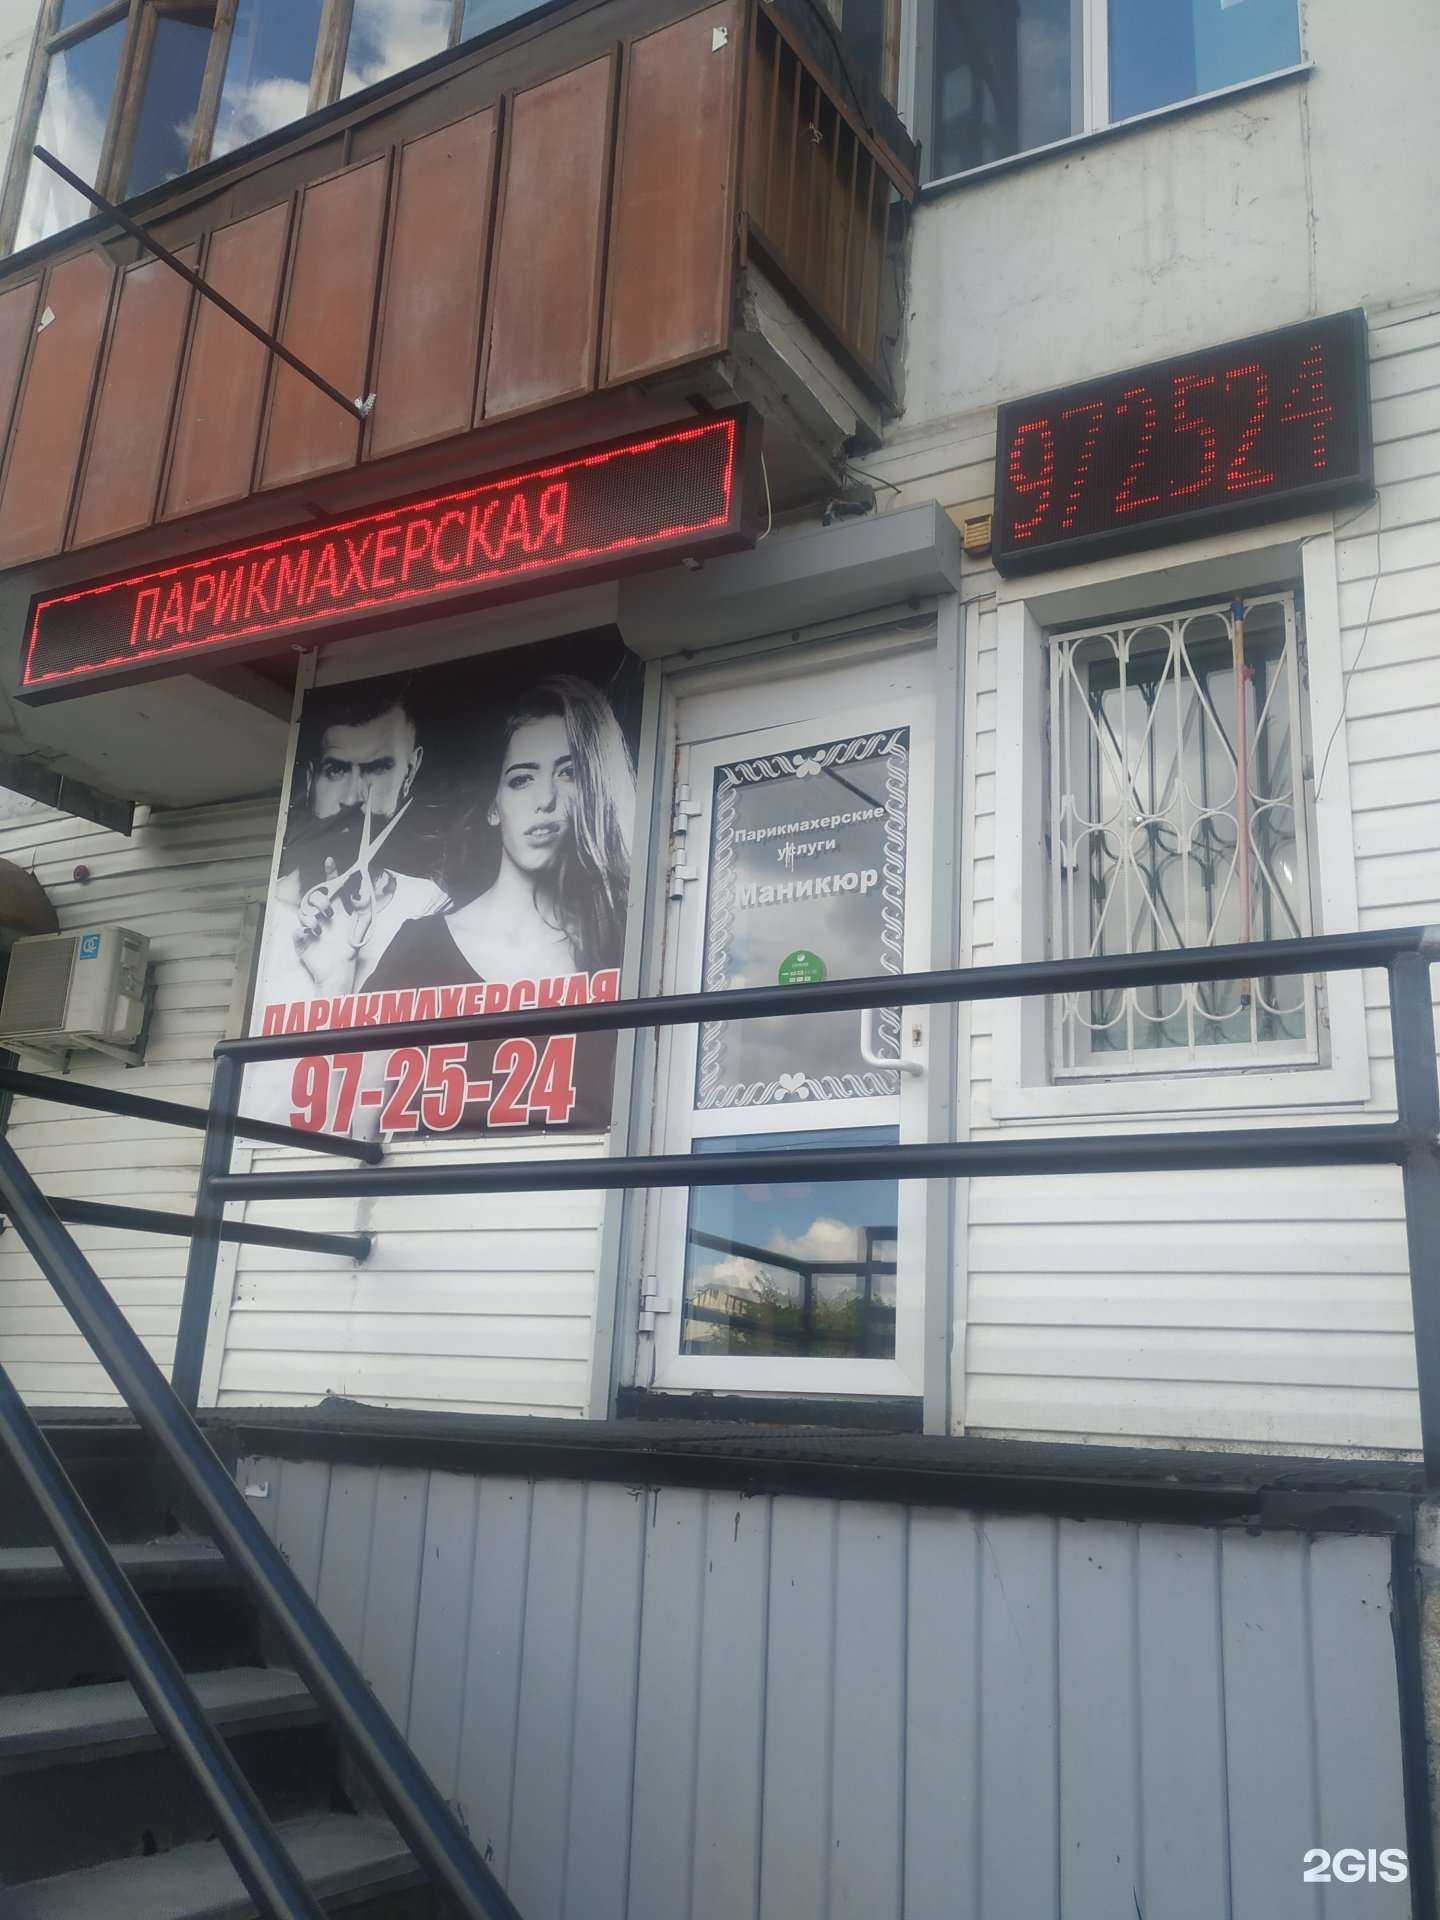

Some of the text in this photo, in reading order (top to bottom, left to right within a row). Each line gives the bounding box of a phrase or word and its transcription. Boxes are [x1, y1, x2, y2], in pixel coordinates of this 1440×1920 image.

[1008, 344, 1334, 540] 972524
[129, 481, 568, 646] ПАРИКМАХЕРСКАЯ
[735, 806, 885, 843] Парикмахерские
[735, 868, 878, 906] Маникюр
[289, 1034, 576, 1133] 97-25-24
